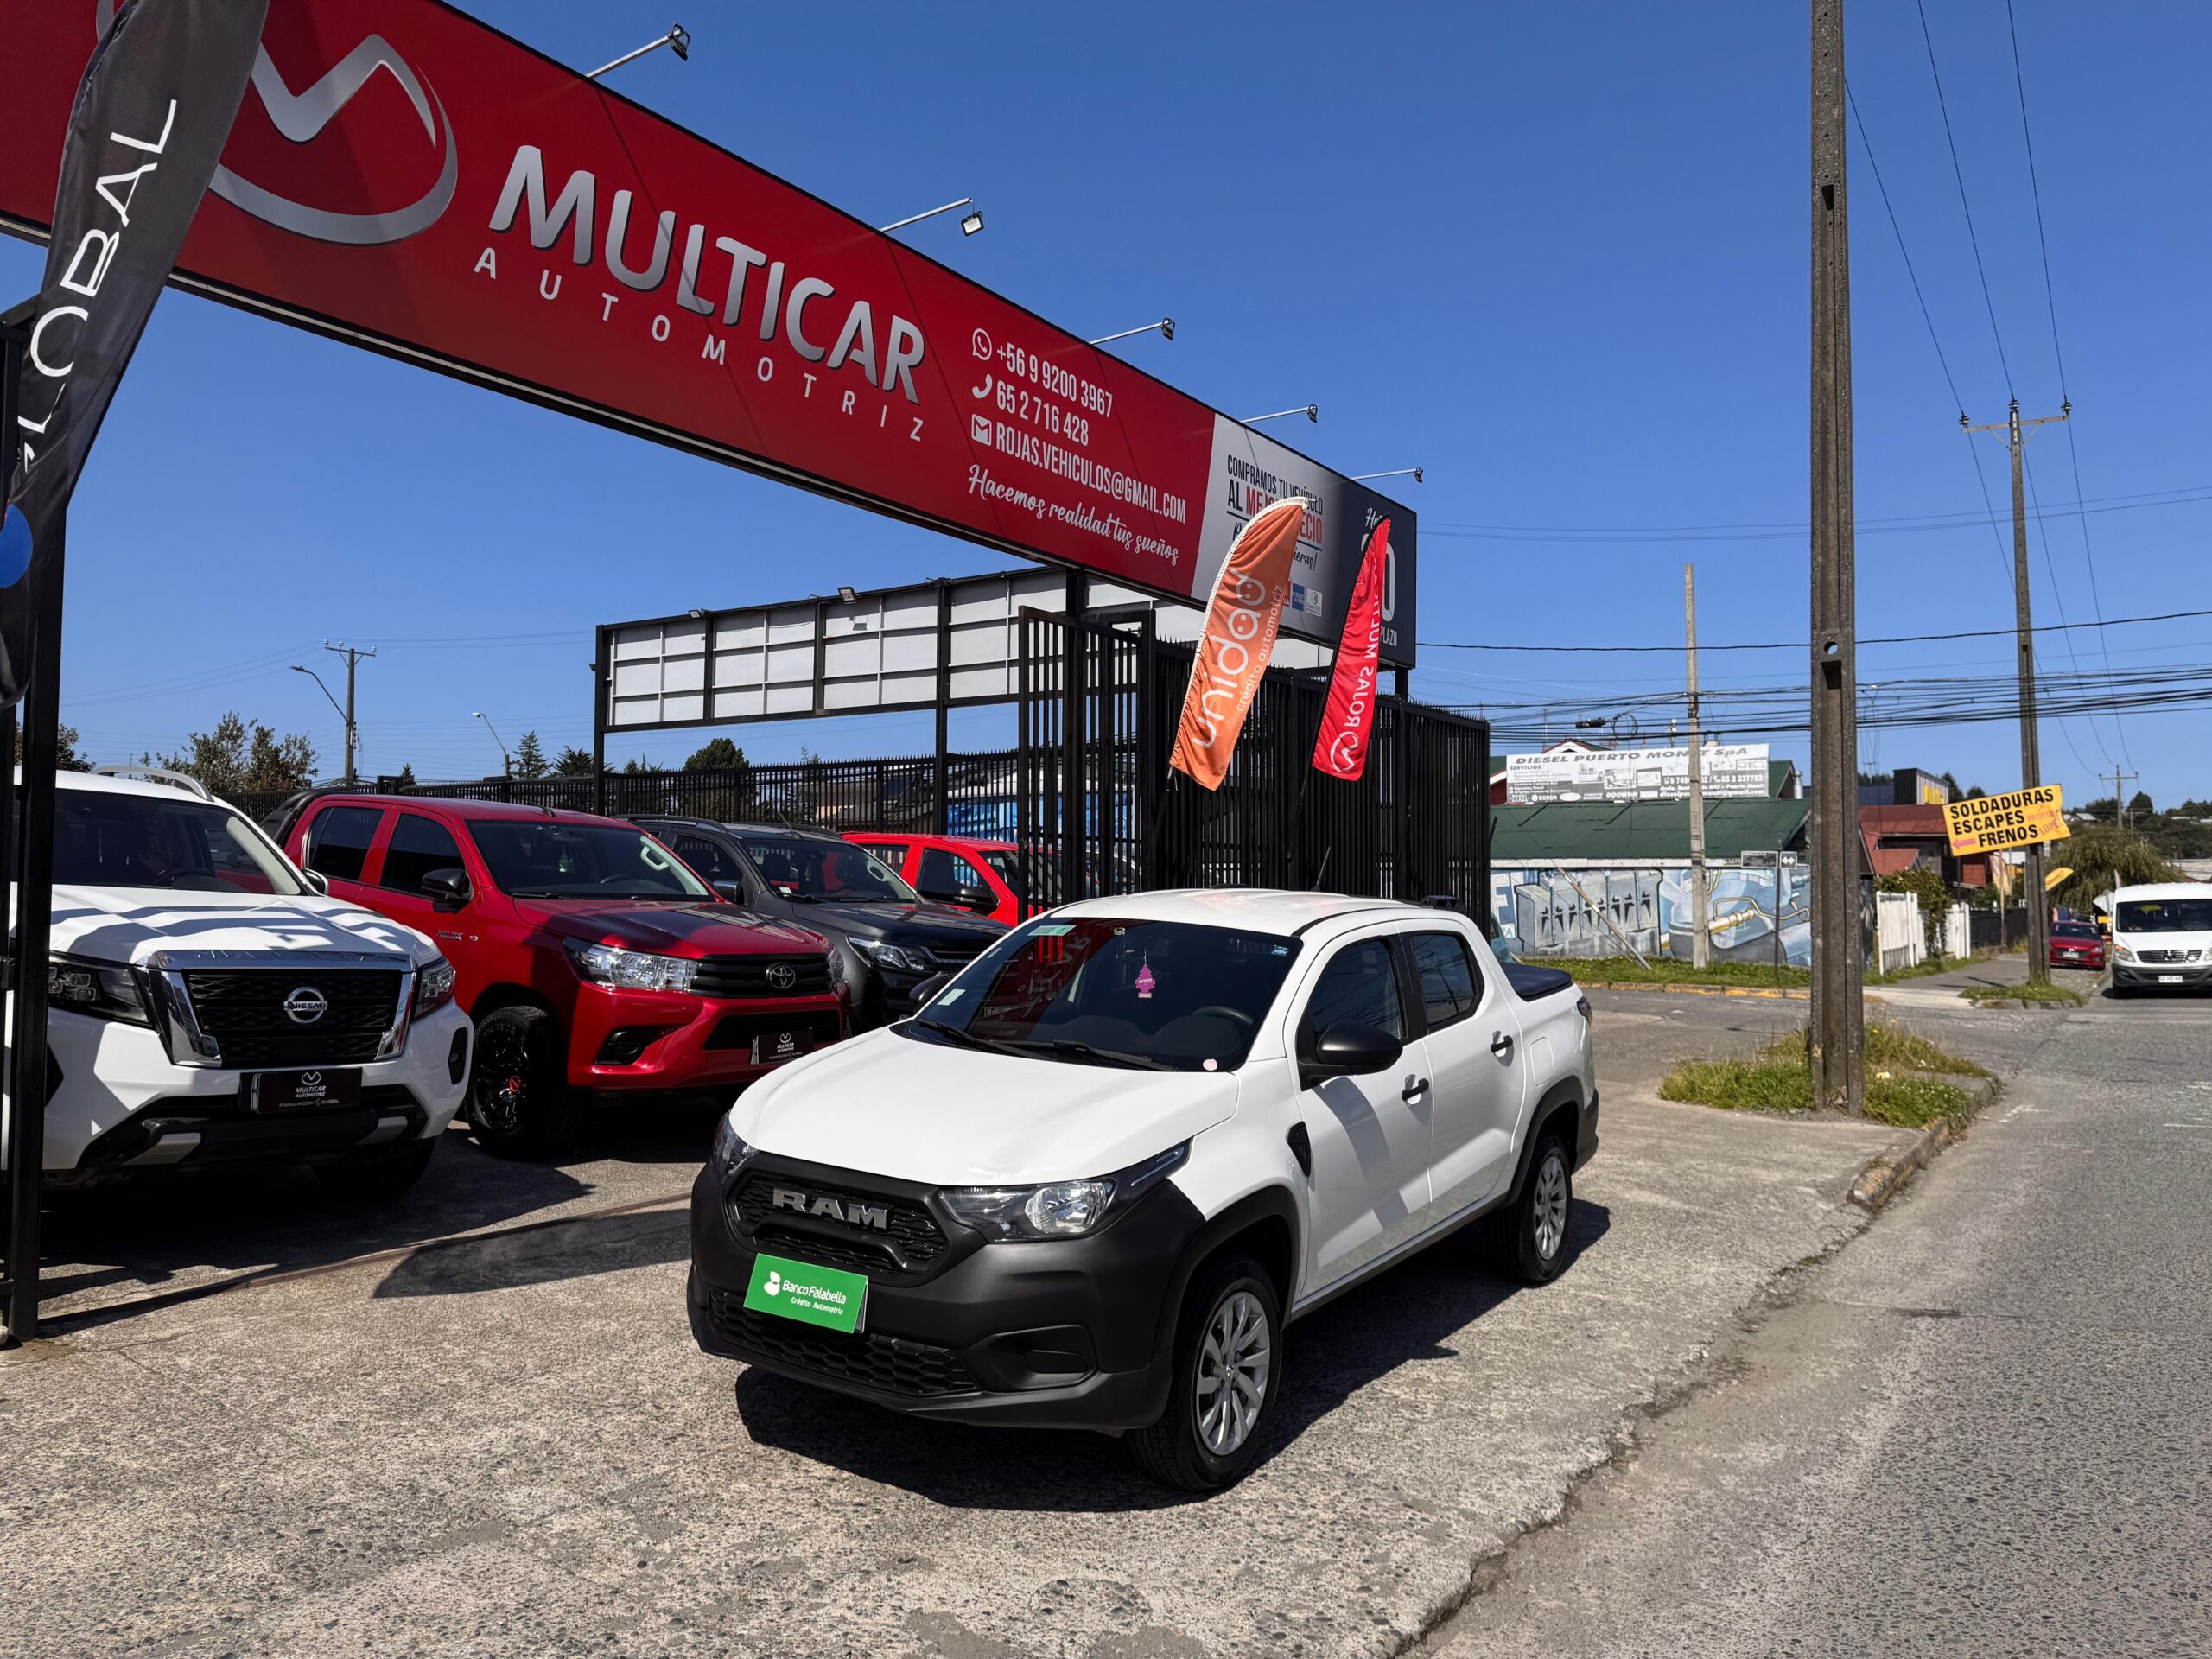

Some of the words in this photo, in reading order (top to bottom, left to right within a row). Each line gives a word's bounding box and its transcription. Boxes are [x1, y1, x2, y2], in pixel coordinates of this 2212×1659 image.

[17, 99, 177, 474] LOBAL
[488, 145, 925, 405] MULTICAR
[474, 247, 924, 441] AUTOMOTRIZ
[996, 343, 1026, 378] +56
[1029, 354, 1038, 384] 9
[1042, 360, 1077, 402] 9200
[1080, 379, 1113, 418] 3967
[996, 380, 1016, 414] 65
[1020, 391, 1029, 420] 2
[1033, 397, 1060, 434] 716
[1063, 412, 1089, 447] 428
[995, 422, 1186, 524] ROJAS.VEHICULOS@GMAIL.COM
[1227, 454, 1277, 494] COMPRAMOS
[1278, 479, 1288, 499] TU
[968, 464, 1047, 519] Hacemos
[1049, 502, 1112, 537] realidad
[1107, 514, 1135, 550] tus
[1135, 535, 1180, 567] sueños
[1227, 479, 1243, 512] AL
[1300, 511, 1323, 544] ECIO
[1192, 568, 1266, 749] unidad
[1236, 664, 1262, 713] crédito
[1258, 583, 1285, 660] automotriz
[1516, 755, 1569, 764] DIESEL
[1573, 752, 1641, 762] PUERTO
[1646, 749, 1710, 760] MONT
[1714, 747, 1749, 757] SpA
[1949, 788, 2054, 820] SOLDADURAS
[1953, 810, 2025, 836] ESCAPES
[1978, 824, 2038, 848] FRENOS
[295, 1085, 327, 1094] MULTICAR
[772, 1186, 887, 1230] RAM
[782, 1280, 809, 1296] Banco
[808, 1286, 847, 1305] Falabella
[791, 1297, 811, 1307] Crédito
[812, 1302, 844, 1315] Automotriz
